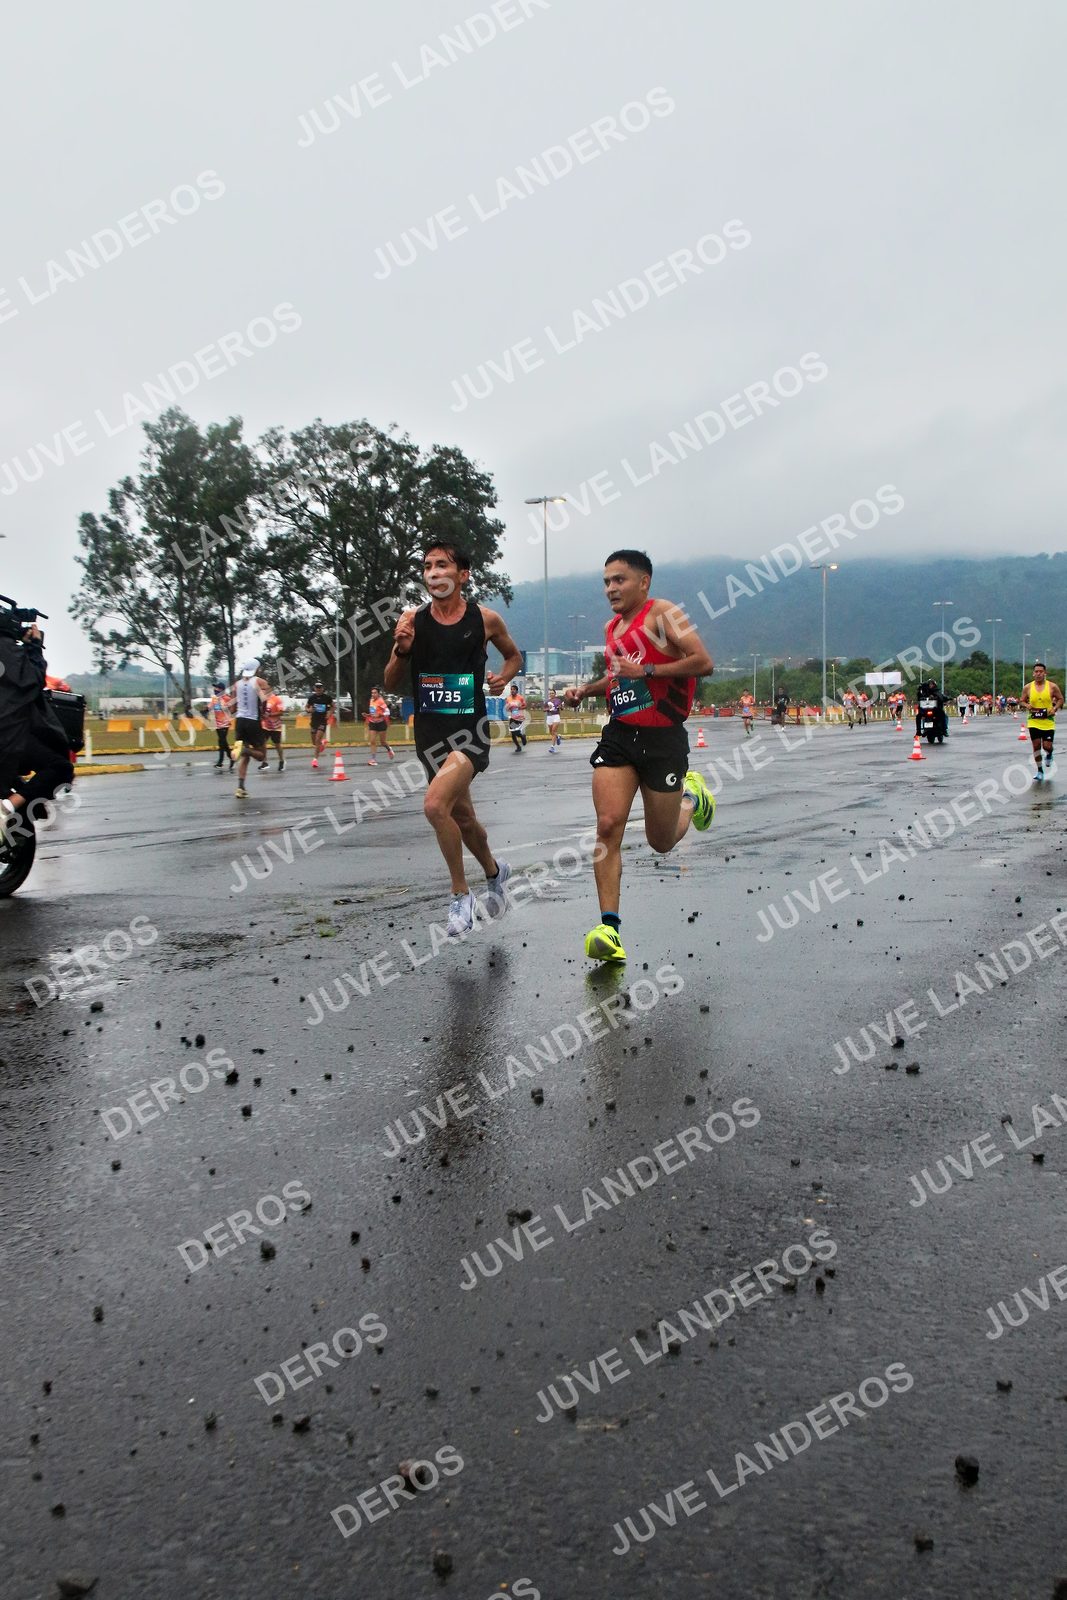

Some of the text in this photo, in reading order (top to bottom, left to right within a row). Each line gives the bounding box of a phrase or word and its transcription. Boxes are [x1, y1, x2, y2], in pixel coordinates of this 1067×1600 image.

[458, 677, 470, 686] 10K
[429, 690, 461, 702] 1735
[613, 689, 637, 706] 1662
